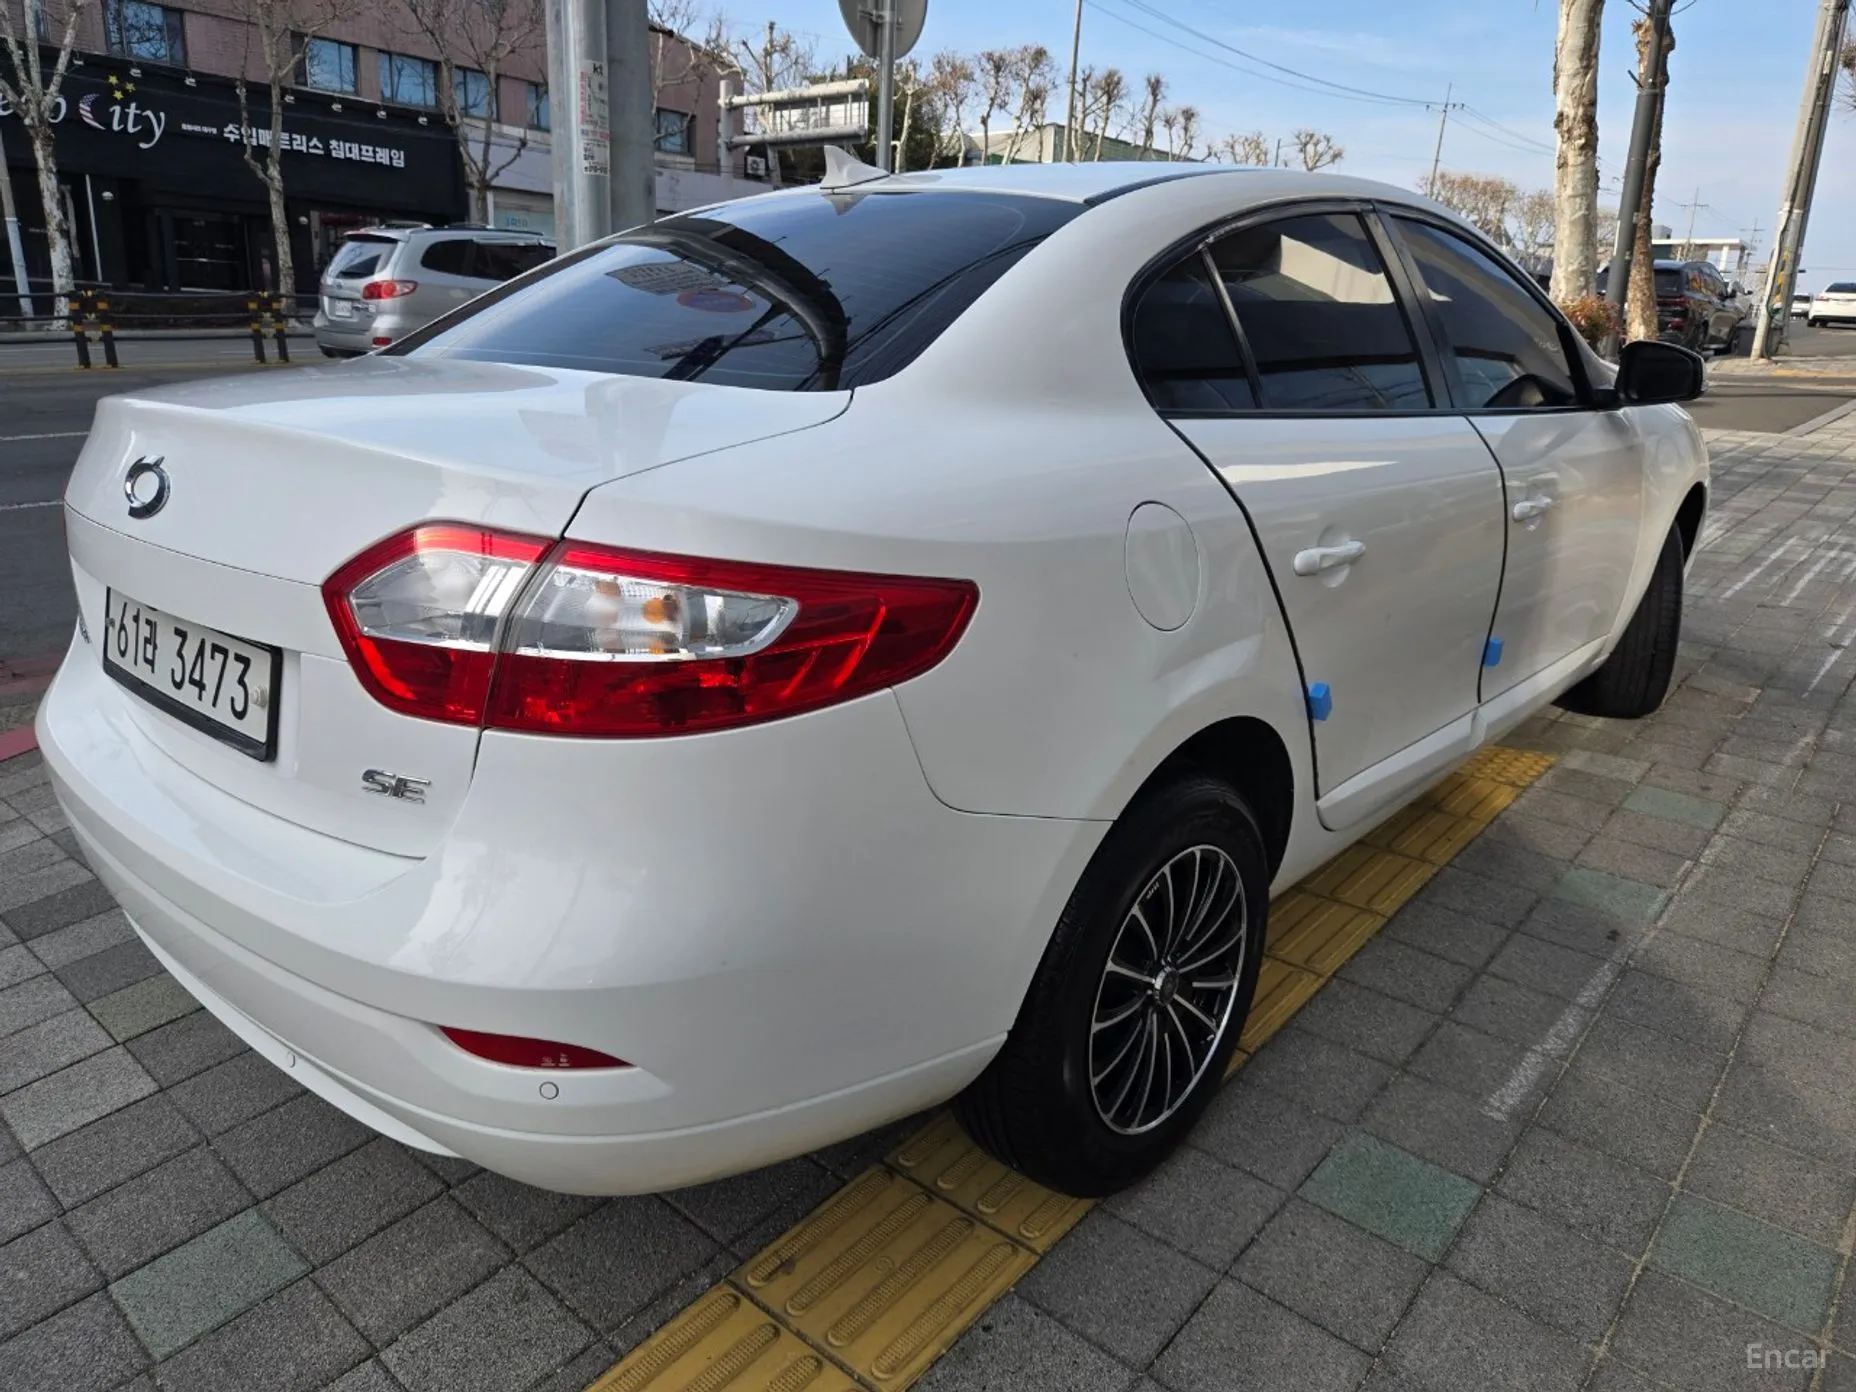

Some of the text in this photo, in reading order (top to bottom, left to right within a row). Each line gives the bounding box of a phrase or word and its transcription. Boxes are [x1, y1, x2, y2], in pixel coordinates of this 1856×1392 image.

[329, 139, 405, 167] 침대프레임
[117, 602, 252, 720] 61라 3473
[362, 769, 432, 804] SE
